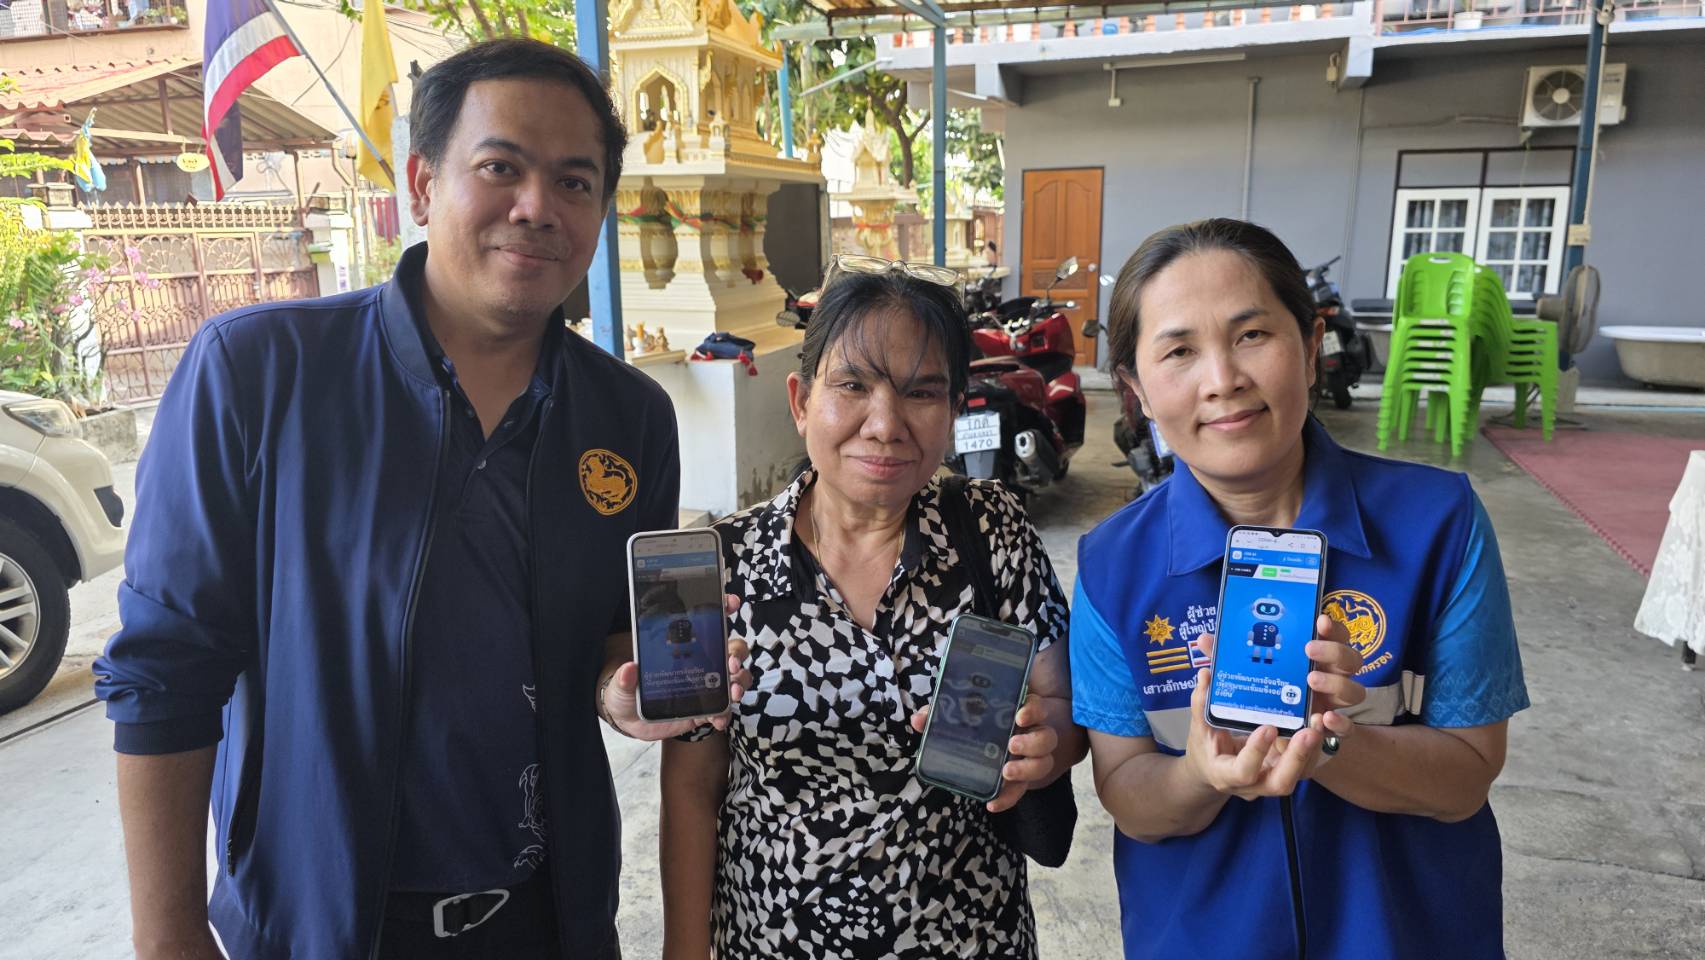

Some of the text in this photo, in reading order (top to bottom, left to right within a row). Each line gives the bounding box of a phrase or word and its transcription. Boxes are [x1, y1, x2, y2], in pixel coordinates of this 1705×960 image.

[965, 439, 993, 450] 1470
[1187, 605, 1216, 623] ผู้ช่วย
[1179, 618, 1216, 640] ผู้ใหญ่บ้
